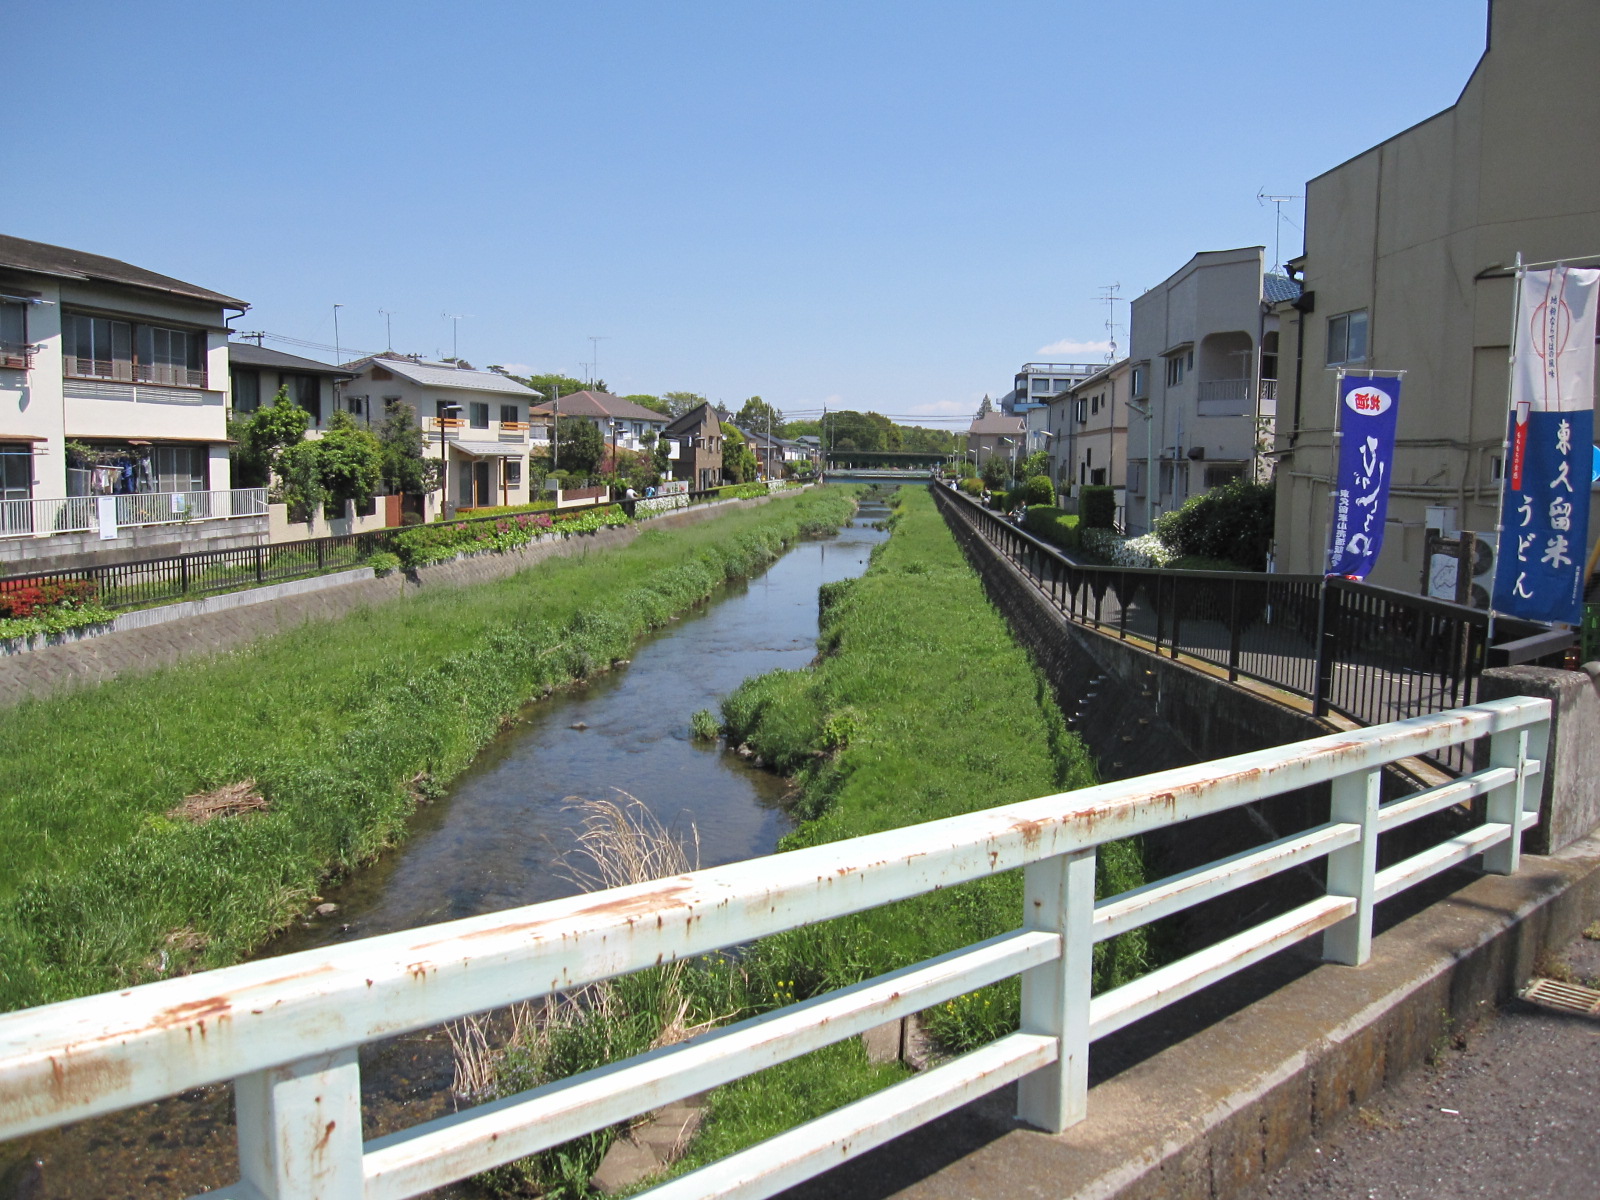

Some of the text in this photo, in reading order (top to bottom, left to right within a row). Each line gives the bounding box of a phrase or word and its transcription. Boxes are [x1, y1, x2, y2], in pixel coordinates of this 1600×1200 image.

[1512, 494, 1536, 599] うどん
[1541, 418, 1573, 569] 東久留米
